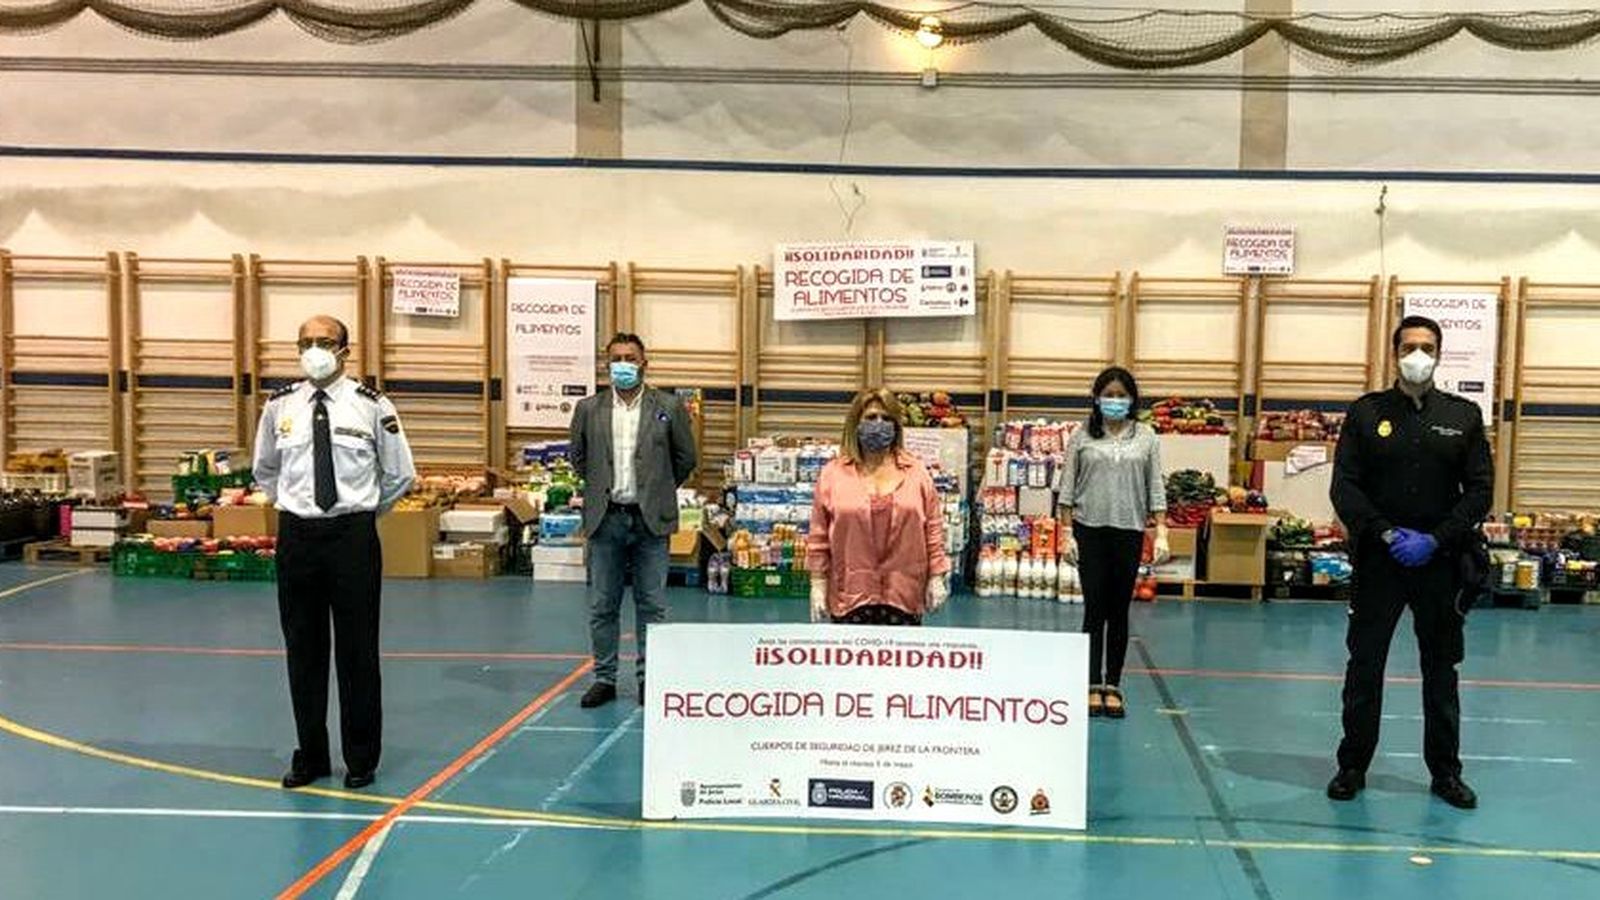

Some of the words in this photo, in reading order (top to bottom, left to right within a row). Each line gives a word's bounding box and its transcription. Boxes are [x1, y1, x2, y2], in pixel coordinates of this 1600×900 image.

[785, 268, 883, 287] RECOGIDA
[890, 268, 914, 284] DE
[793, 287, 907, 306] ALIMENTOS
[1409, 297, 1469, 309] RECOGIDA
[1472, 298, 1486, 309] DE
[511, 302, 569, 315] RECOGIDA
[571, 304, 587, 315] DE
[515, 323, 582, 336] ALIMENTOS
[663, 691, 824, 718] RECOGIDA
[835, 692, 874, 718] DE
[886, 693, 1069, 725] ALIMENTOS
[750, 741, 793, 751] CUERPOS
[795, 741, 807, 751] DE
[809, 742, 861, 753] SEGURIDAD
[863, 743, 875, 753] DE
[877, 744, 902, 754] JEREZ
[904, 744, 916, 754] DE
[918, 745, 930, 754] LA
[932, 745, 980, 756] FRONTERA
